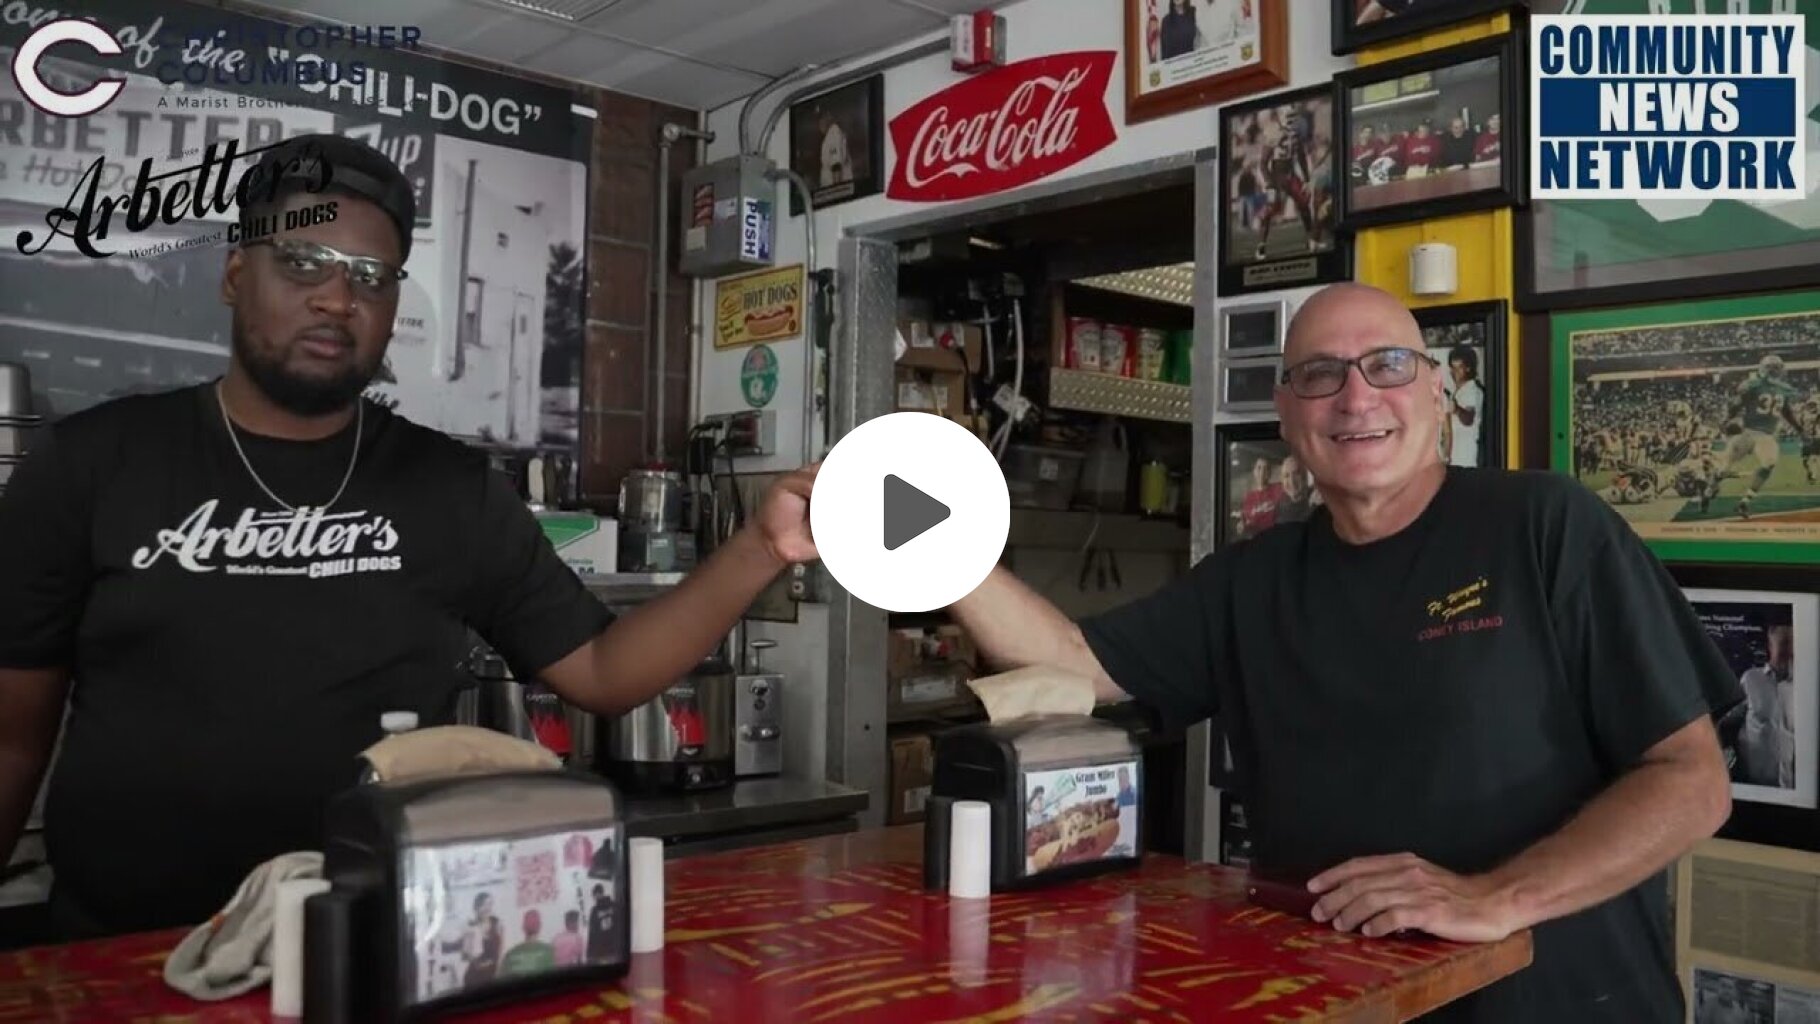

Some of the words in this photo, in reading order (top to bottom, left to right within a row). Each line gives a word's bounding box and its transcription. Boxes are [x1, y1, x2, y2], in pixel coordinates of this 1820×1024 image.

[117, 16, 164, 69] of
[745, 201, 758, 255] PUSH
[767, 281, 797, 305] DOGS
[131, 498, 400, 572] Arbetter's
[308, 556, 355, 579] CHILI
[356, 554, 402, 572] DOGS
